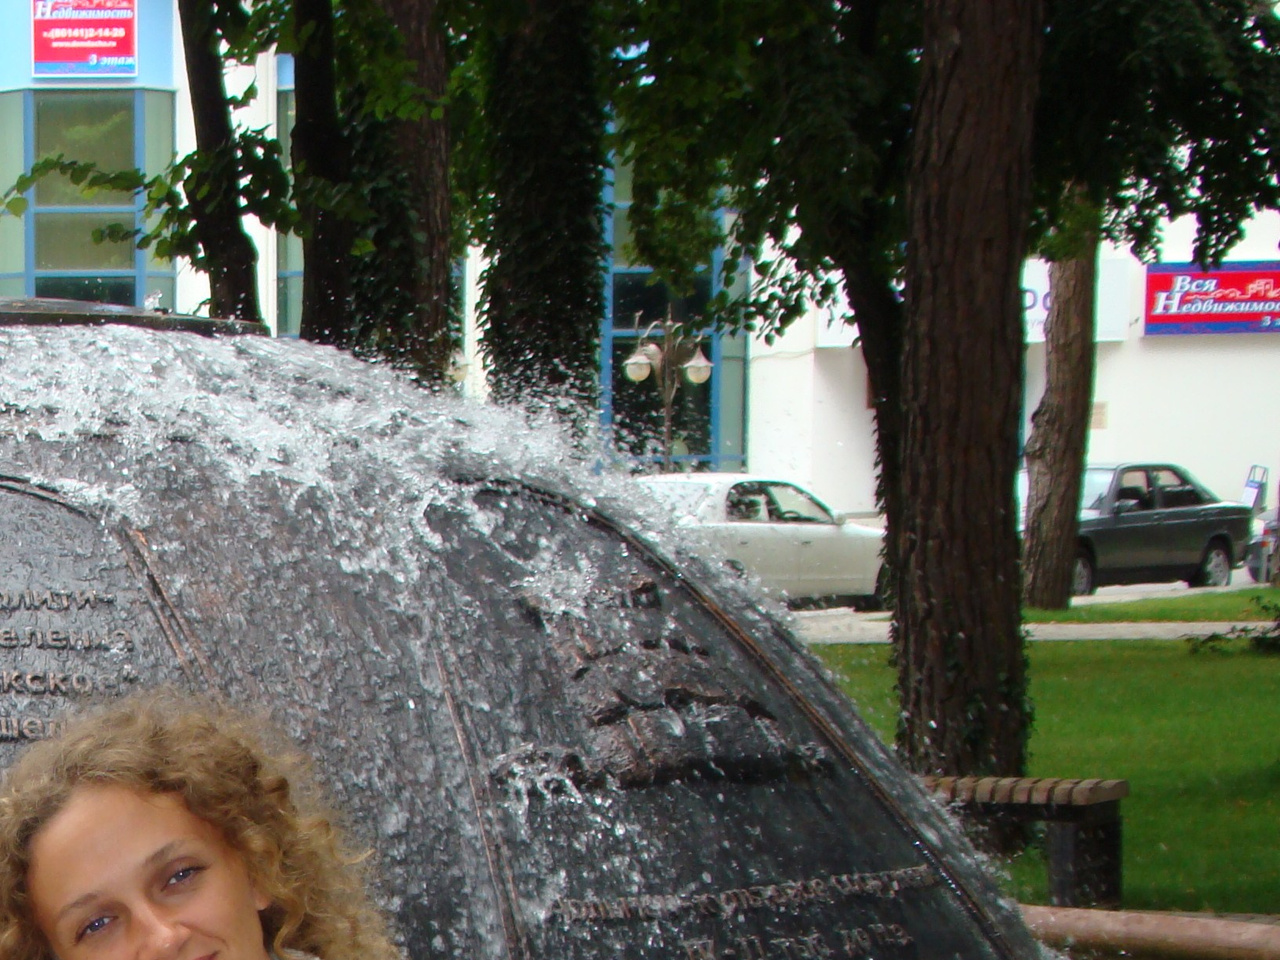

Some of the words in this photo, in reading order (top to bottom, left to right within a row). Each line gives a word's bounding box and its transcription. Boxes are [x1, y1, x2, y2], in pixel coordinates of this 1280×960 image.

[34, 1, 133, 19] Недвижимость
[89, 54, 98, 66] 3
[1173, 275, 1218, 293] Вся
